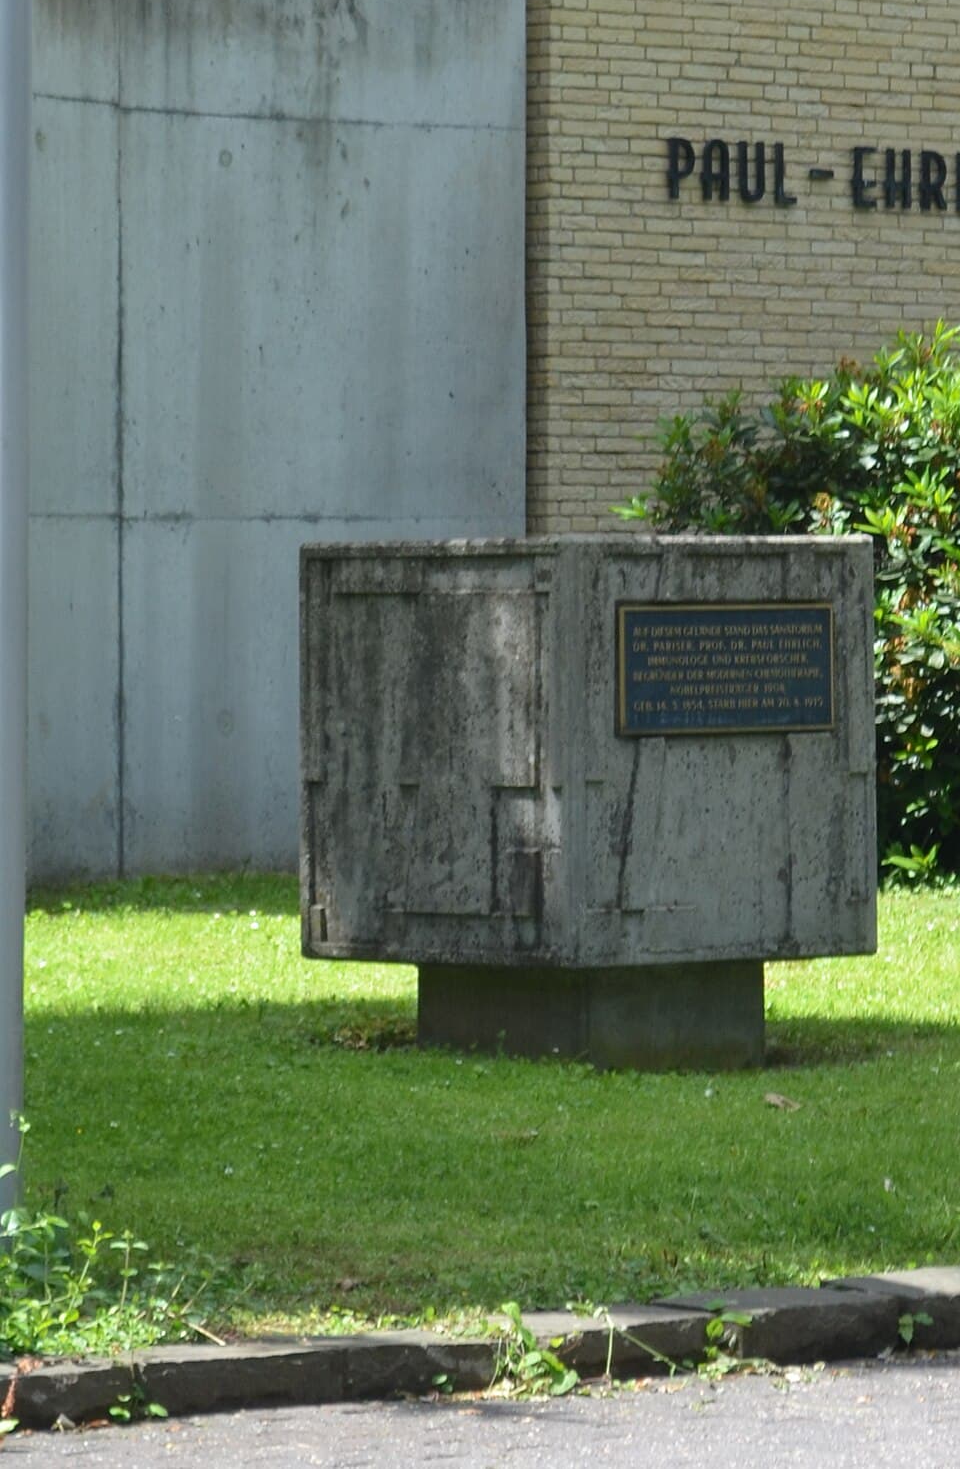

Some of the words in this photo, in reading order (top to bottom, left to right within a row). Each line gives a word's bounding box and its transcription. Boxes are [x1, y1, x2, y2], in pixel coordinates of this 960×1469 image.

[752, 625, 768, 636] DAS
[699, 640, 727, 651] PROF.
[730, 639, 747, 651] DR.
[751, 639, 774, 651] PAUL
[712, 654, 732, 666] UND
[686, 669, 704, 680] DER
[738, 698, 759, 709] HIER
[761, 697, 775, 708] AM
